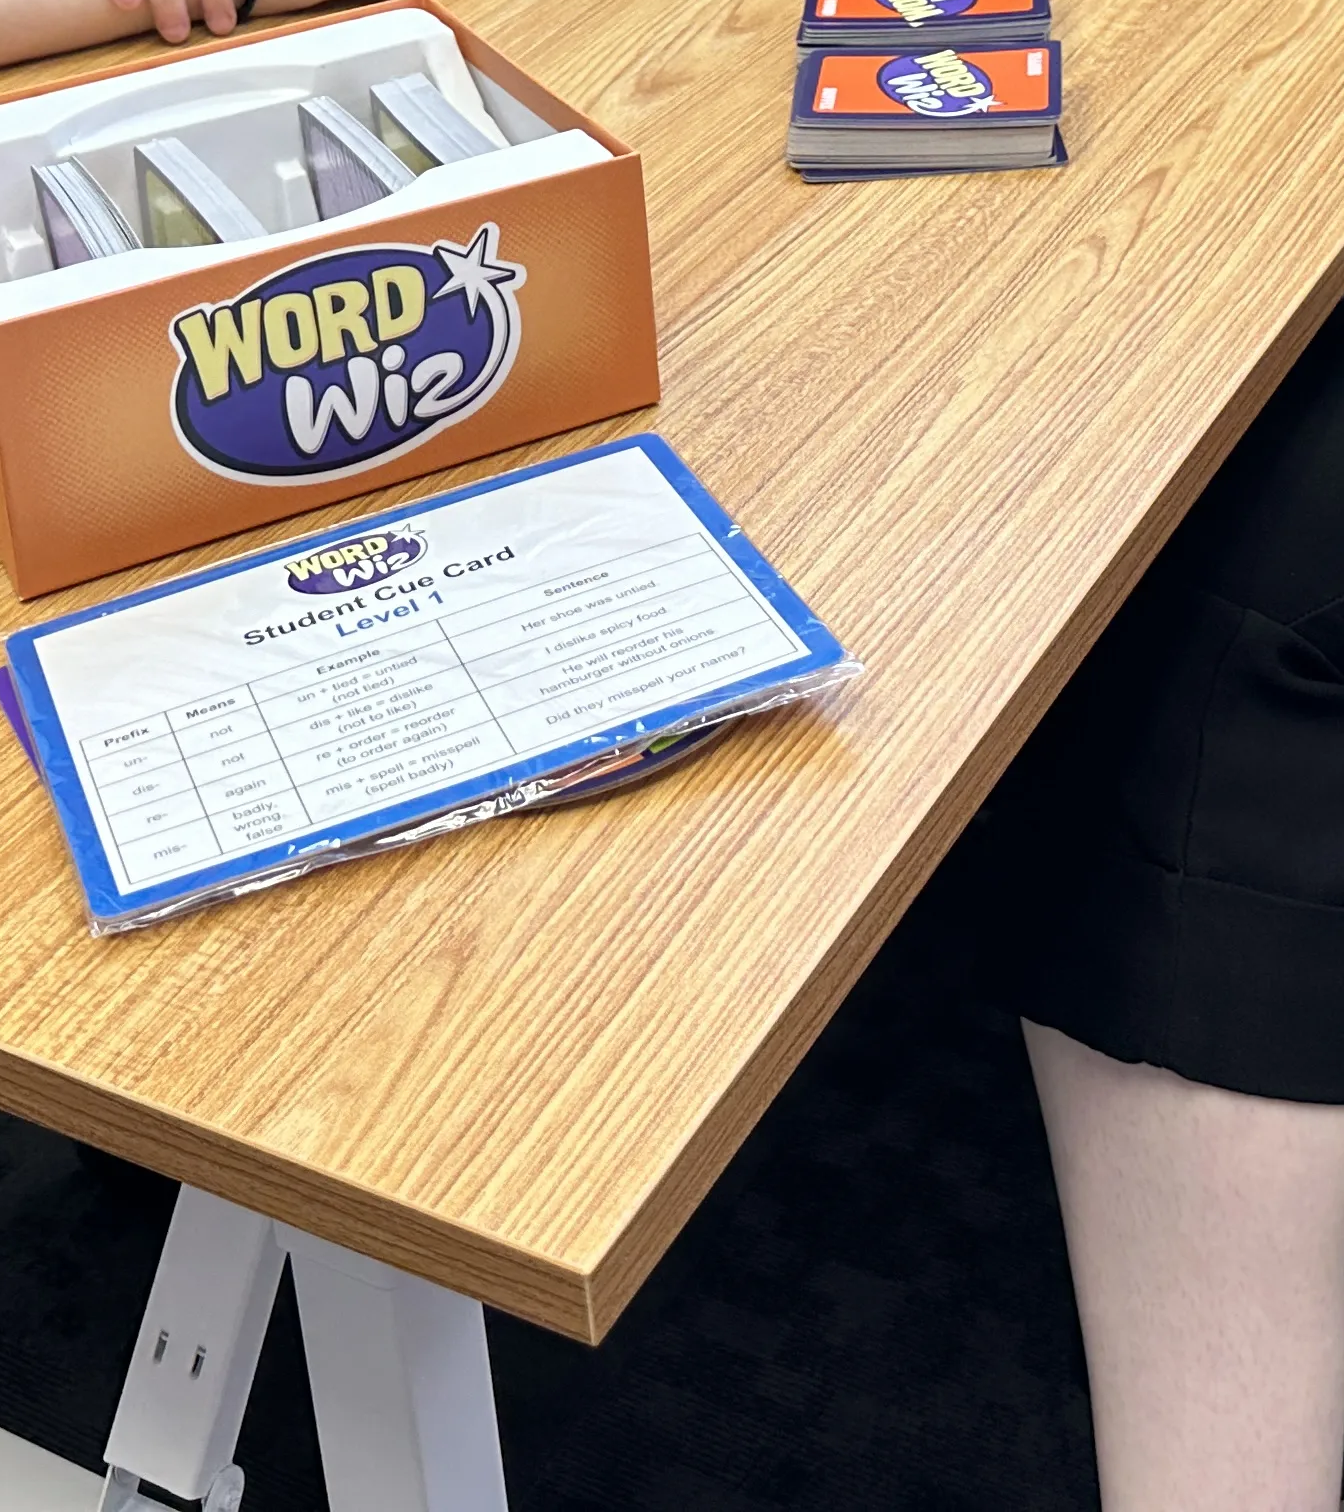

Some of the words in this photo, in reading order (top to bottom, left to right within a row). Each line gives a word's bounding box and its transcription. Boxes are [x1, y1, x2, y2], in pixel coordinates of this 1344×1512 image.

[914, 49, 986, 98] WORD
[176, 265, 426, 400] WORD
[284, 345, 464, 456] Wiz
[286, 536, 388, 582] WORD
[332, 554, 410, 587] Wiz
[244, 595, 367, 646] Student
[374, 576, 434, 601] Cue
[443, 546, 515, 578] Card
[543, 570, 610, 597] Sentence
[335, 599, 420, 637] Level
[428, 590, 444, 604] 1
[520, 617, 547, 632] Her
[550, 604, 583, 622] shoe
[585, 596, 613, 610] was
[554, 631, 597, 652] dislike
[599, 616, 635, 636] spicy
[561, 661, 583, 675] He
[585, 653, 609, 667] will
[611, 635, 660, 659] reorder
[662, 626, 684, 640] his
[297, 691, 316, 703] un
[332, 676, 358, 691] tied
[375, 656, 418, 676] untied
[316, 648, 380, 675] Example
[539, 663, 615, 697] hamburger
[618, 643, 668, 668] without
[332, 688, 360, 704] (not
[364, 676, 395, 693] tied)
[545, 710, 571, 726] Did
[573, 697, 604, 716] they
[608, 676, 665, 703] misspell
[667, 664, 697, 685] your
[700, 646, 747, 670] name?
[185, 697, 236, 720] Means
[309, 717, 331, 730] dis
[347, 703, 373, 718] like
[389, 682, 433, 702] dislike
[338, 718, 365, 734] (not
[369, 711, 384, 722] to
[387, 700, 417, 717] like)
[103, 727, 150, 747] Prefix
[209, 724, 233, 739] not
[316, 750, 332, 762] re
[349, 732, 386, 750] order
[404, 707, 455, 731] reorder
[336, 753, 356, 768] (to
[360, 740, 398, 758] order
[402, 722, 448, 745] again)
[123, 755, 148, 769] un-
[221, 752, 245, 767] not
[325, 780, 353, 796] mis
[369, 762, 404, 782] spell
[421, 736, 481, 764] misspell
[365, 774, 405, 796] (spell
[408, 759, 454, 781] badly)
[132, 782, 160, 797] dis-
[224, 777, 267, 799] again
[146, 811, 168, 824] re-
[246, 822, 283, 842] false
[152, 844, 187, 860] mis-
